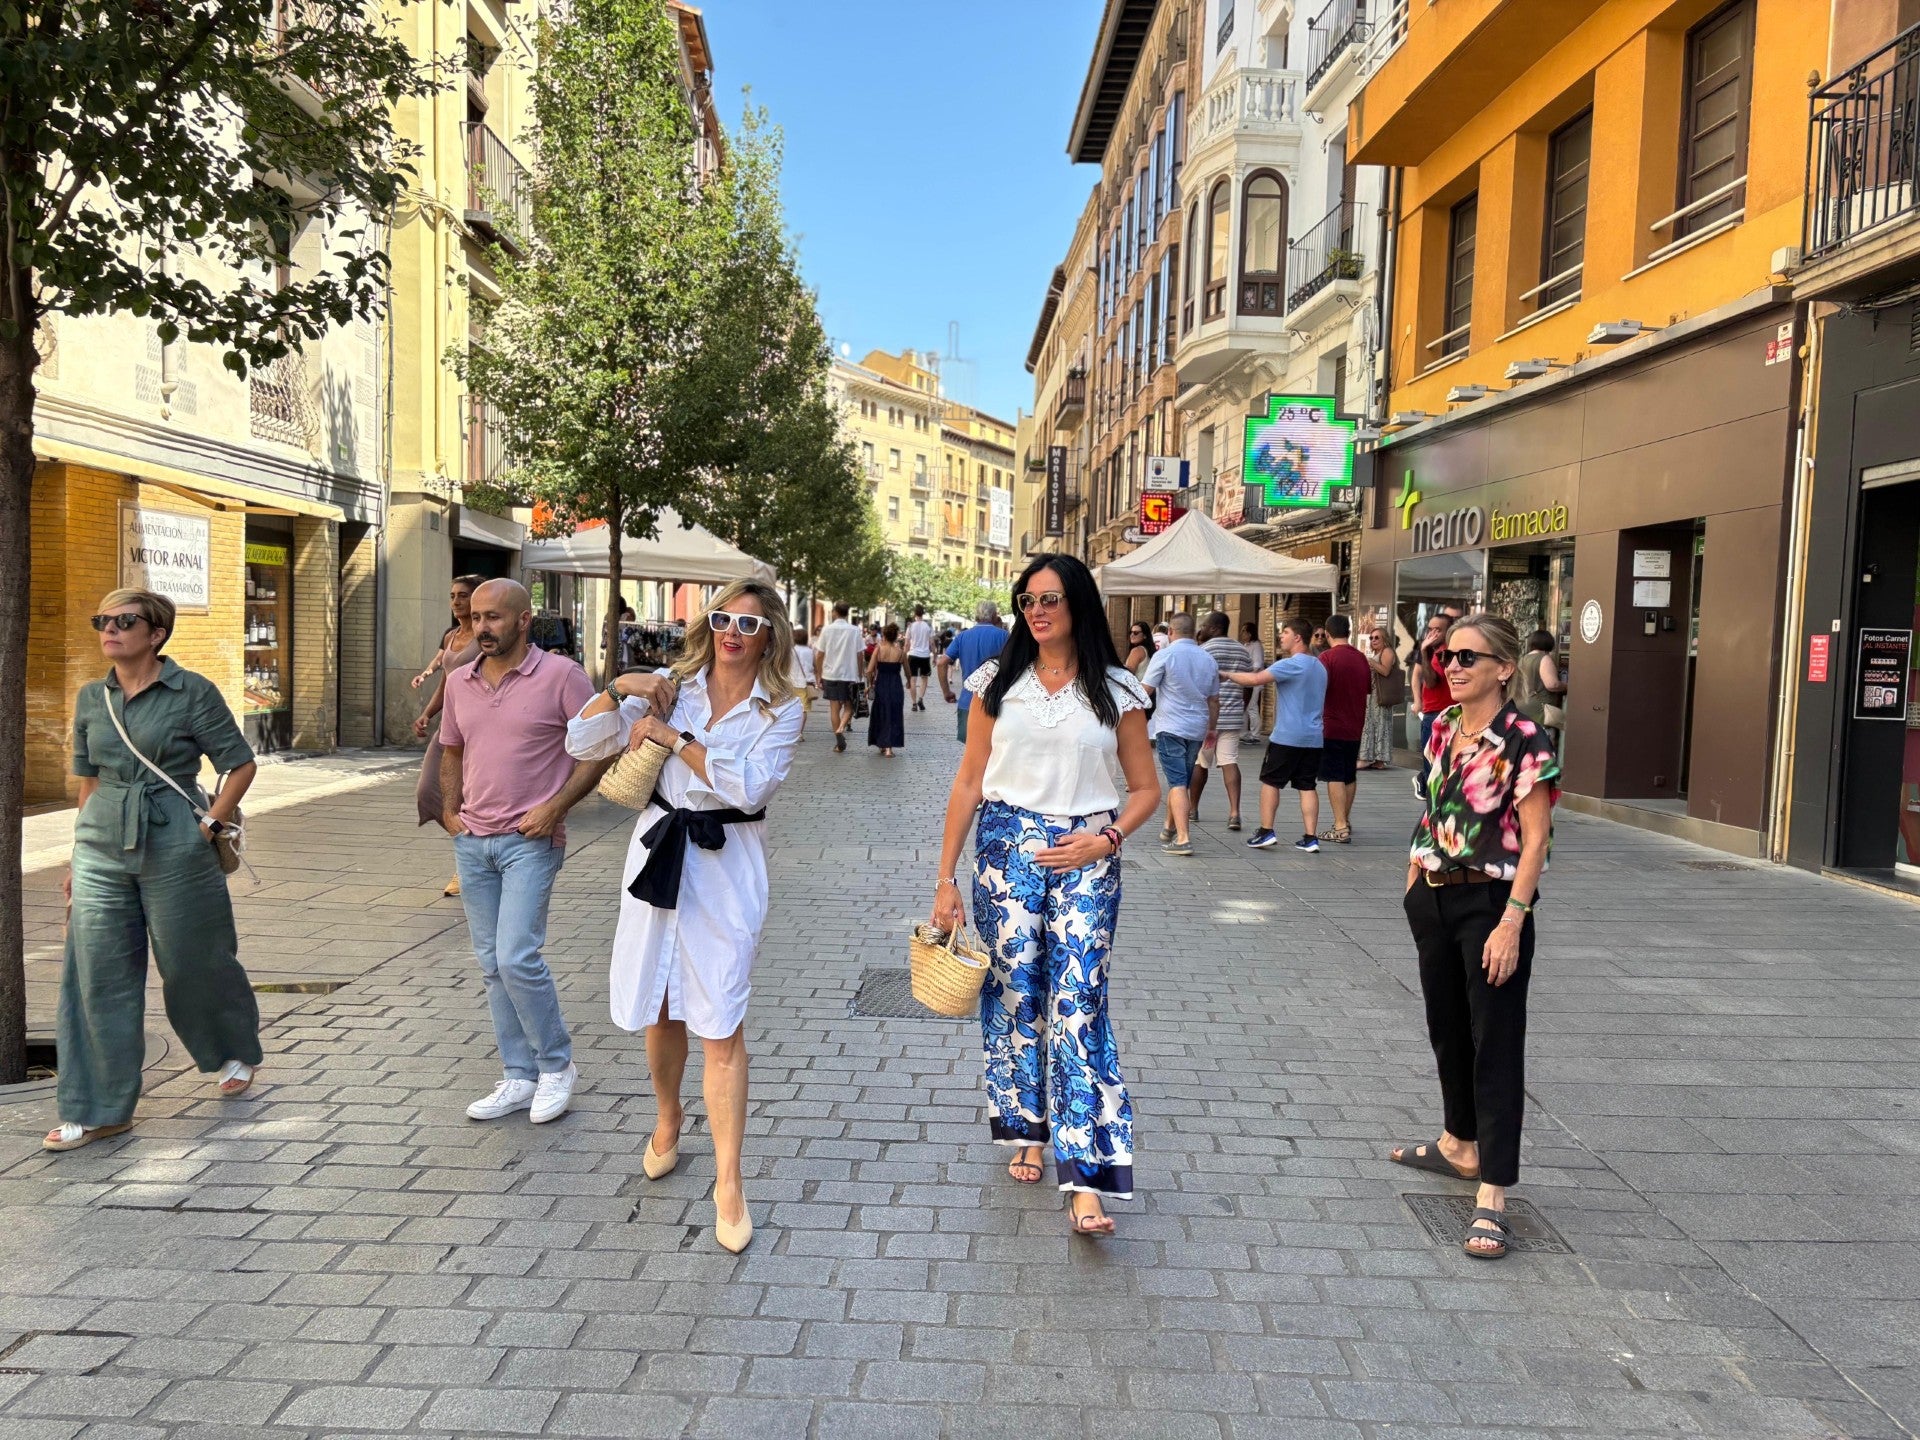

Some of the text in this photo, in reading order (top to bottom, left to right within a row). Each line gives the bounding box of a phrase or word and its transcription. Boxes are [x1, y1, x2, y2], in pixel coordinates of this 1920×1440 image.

[1280, 407, 1295, 420] 25
[1411, 500, 1569, 553] marro farmacia
[130, 547, 203, 570] VICTOR ARNAL
[1864, 634, 1908, 643] Fotos Carnet
